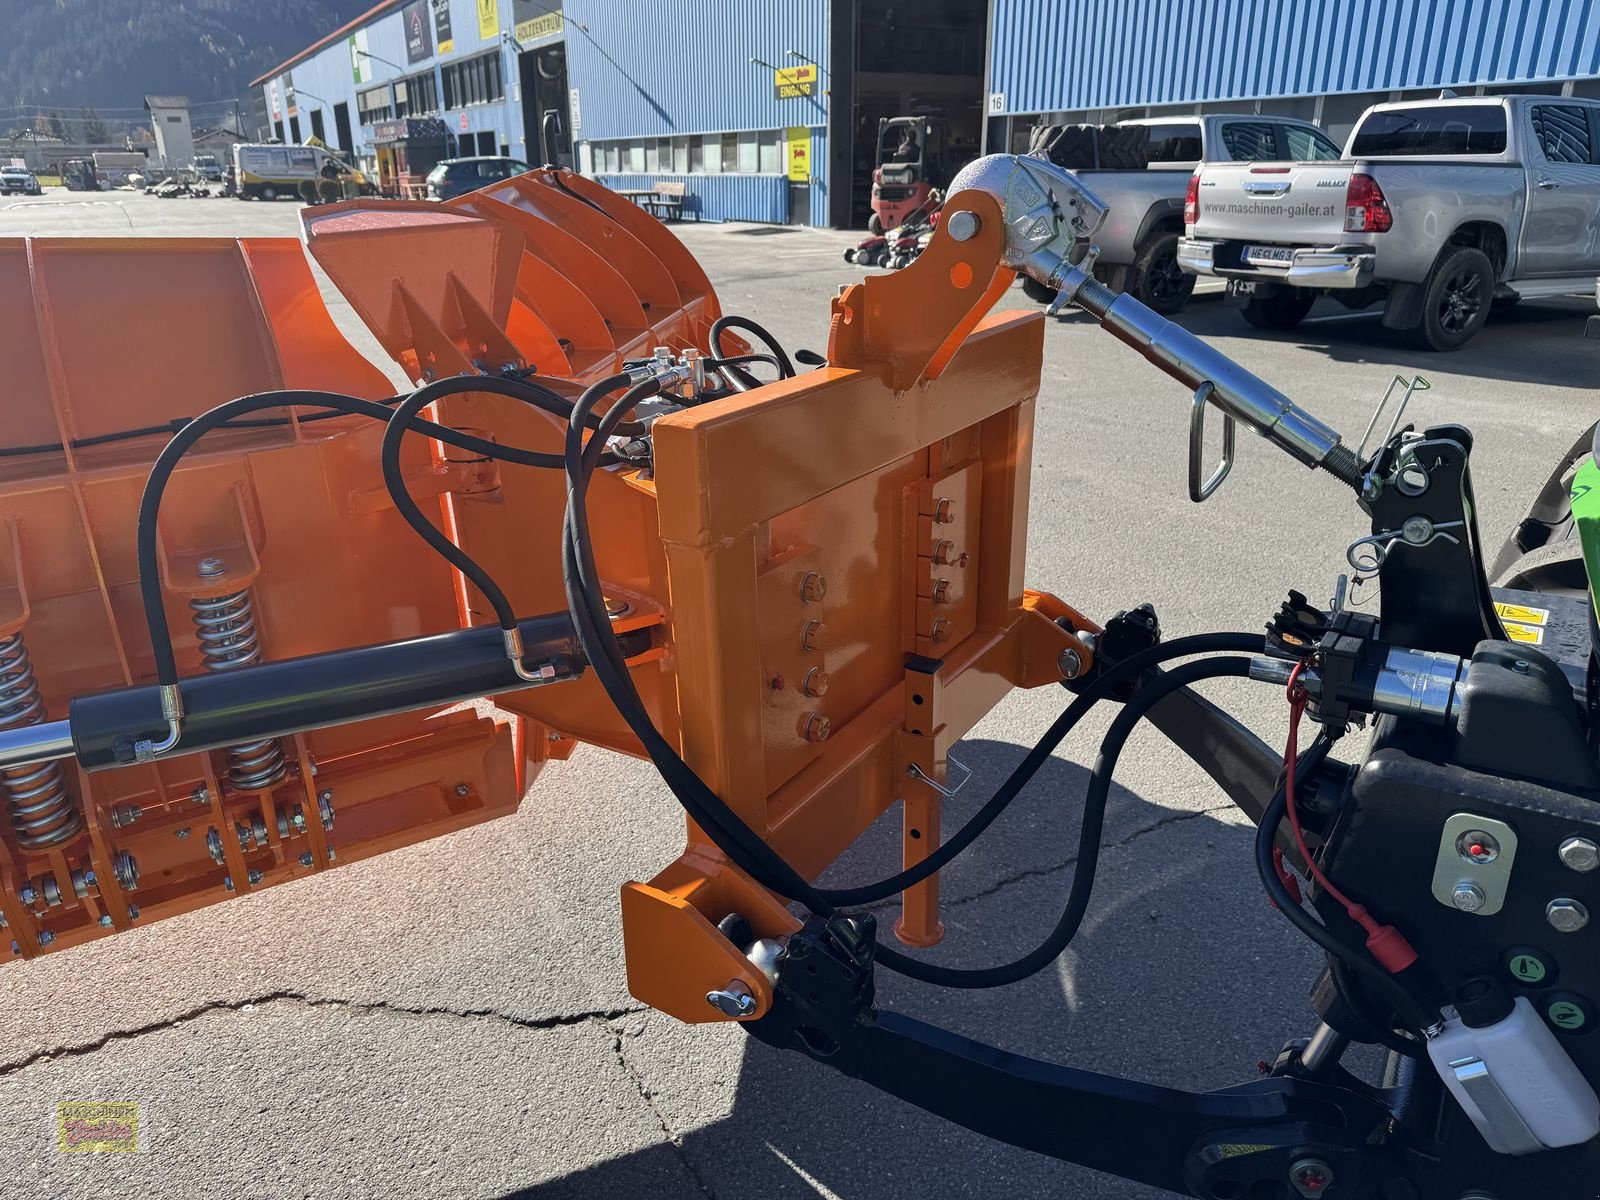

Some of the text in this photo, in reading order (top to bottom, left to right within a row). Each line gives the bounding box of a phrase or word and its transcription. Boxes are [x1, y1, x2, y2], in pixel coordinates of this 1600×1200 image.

[517, 15, 562, 41] HOLZZENTRUM
[780, 84, 810, 98] EINGANG
[992, 96, 1002, 110] 16
[1204, 201, 1335, 218] www.maschinen-gailer.at
